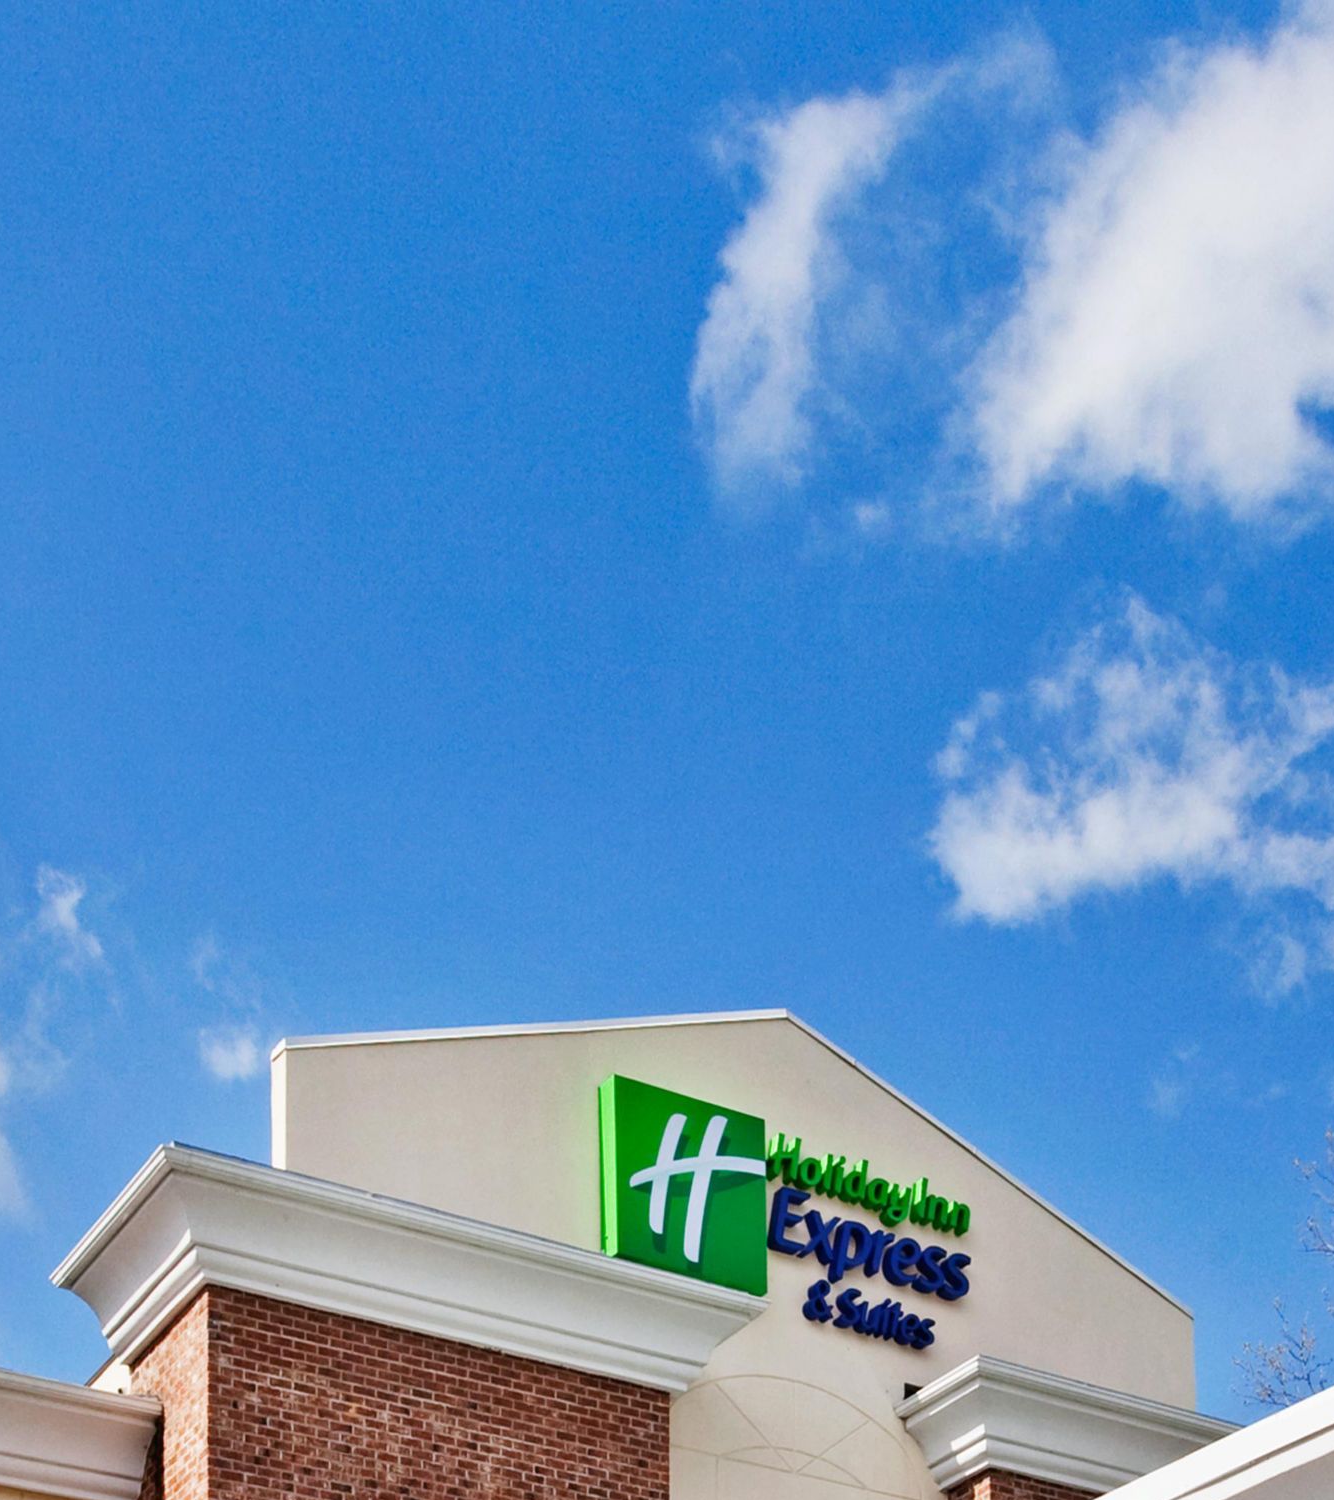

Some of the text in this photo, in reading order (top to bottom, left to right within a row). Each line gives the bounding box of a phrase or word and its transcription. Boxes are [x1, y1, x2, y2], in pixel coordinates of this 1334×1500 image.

[629, 1112, 767, 1264] H
[767, 1186, 971, 1301] Express
[802, 1279, 936, 1350] & Suites
